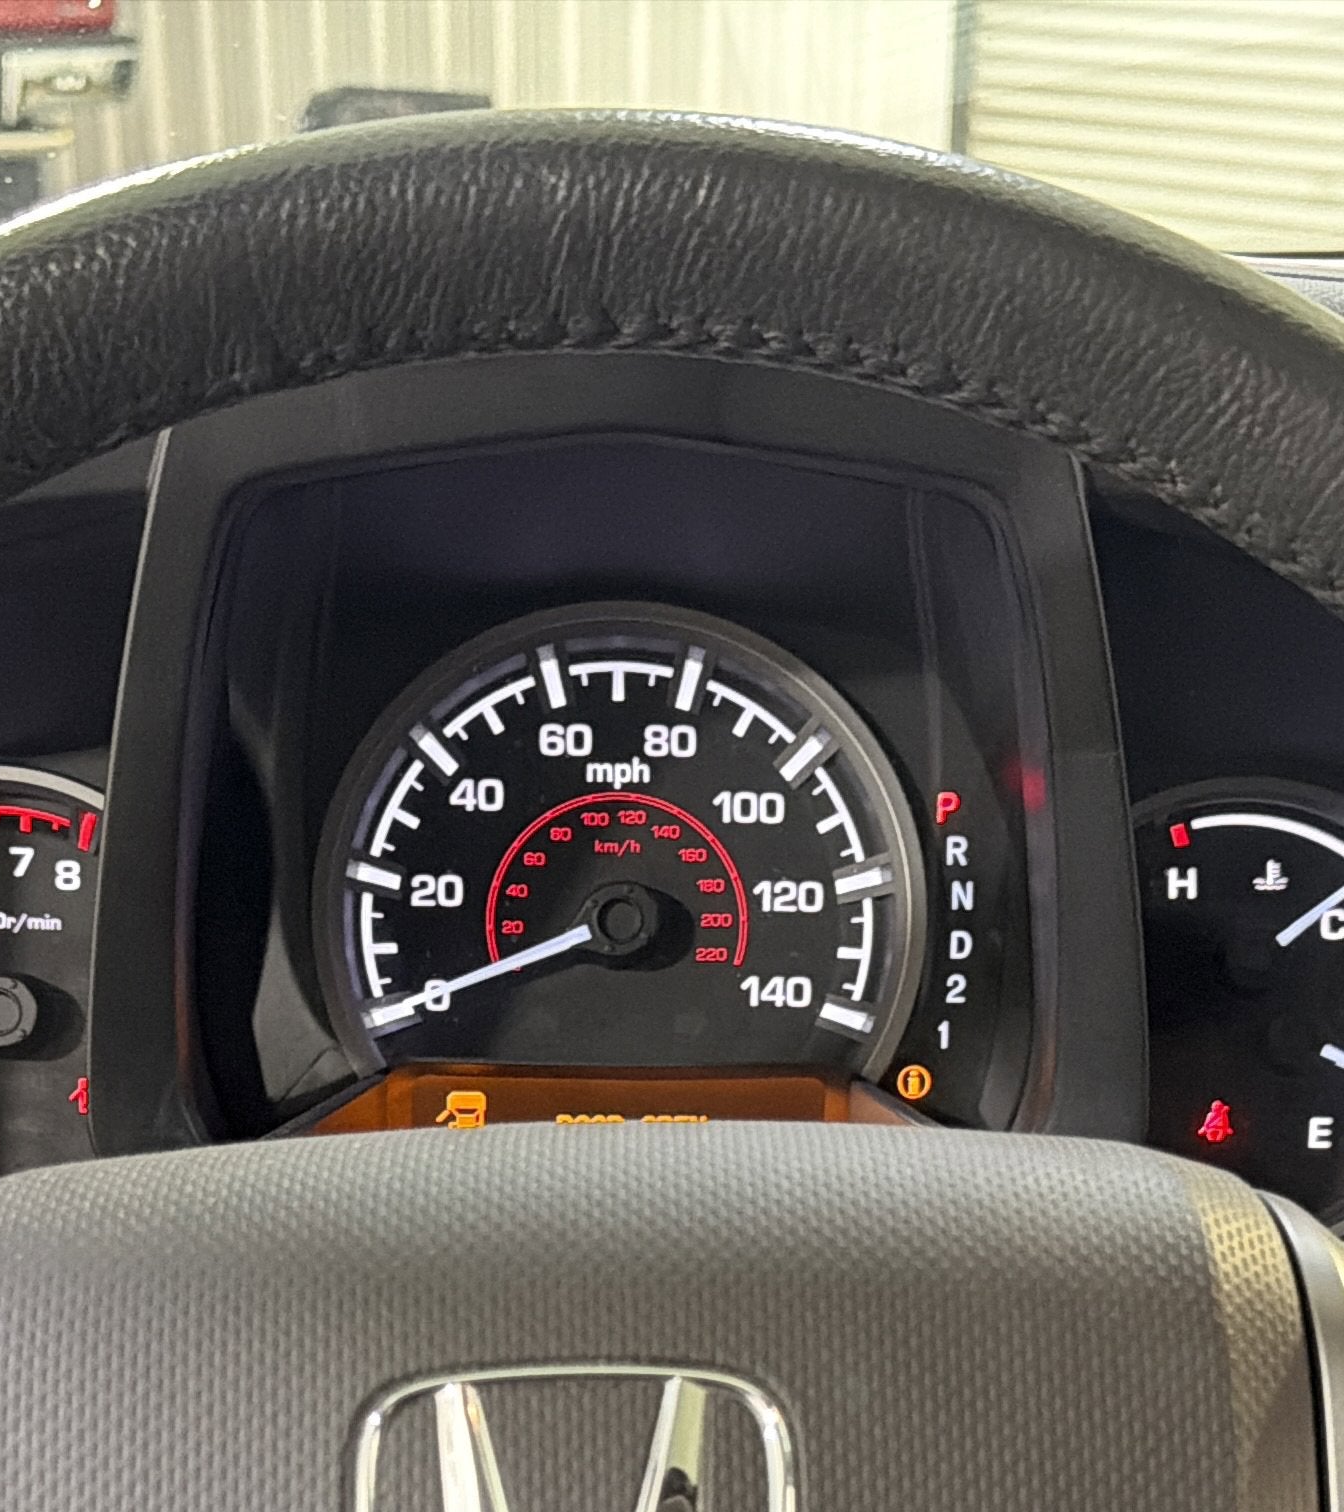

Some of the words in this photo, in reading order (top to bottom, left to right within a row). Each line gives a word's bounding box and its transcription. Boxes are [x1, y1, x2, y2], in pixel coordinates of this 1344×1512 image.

[538, 723, 593, 757] 60
[643, 724, 697, 758] 80
[586, 756, 651, 794] mph
[449, 778, 505, 812] 40
[712, 791, 785, 825] 100
[935, 791, 961, 824] P
[580, 812, 610, 827] 100
[617, 810, 647, 825] 120
[651, 824, 681, 840] 140
[550, 827, 572, 842] 80
[594, 839, 641, 857] km/h
[8, 846, 35, 878] 7
[523, 851, 546, 866] 60
[678, 848, 708, 863] 160
[946, 835, 968, 867] R
[54, 859, 81, 891] 8
[696, 878, 725, 893] 180
[1166, 867, 1198, 900] H
[410, 874, 464, 908] 20
[505, 884, 529, 898] 40
[752, 880, 824, 913] 120
[951, 880, 974, 911] N
[501, 920, 524, 934] 20
[700, 913, 733, 928] 200
[695, 947, 728, 962] 220
[949, 930, 973, 960] D
[423, 979, 452, 1012] 0
[740, 975, 812, 1008] 140
[945, 974, 968, 1004] 2
[937, 1020, 949, 1050] 1
[1307, 1116, 1334, 1149] E
